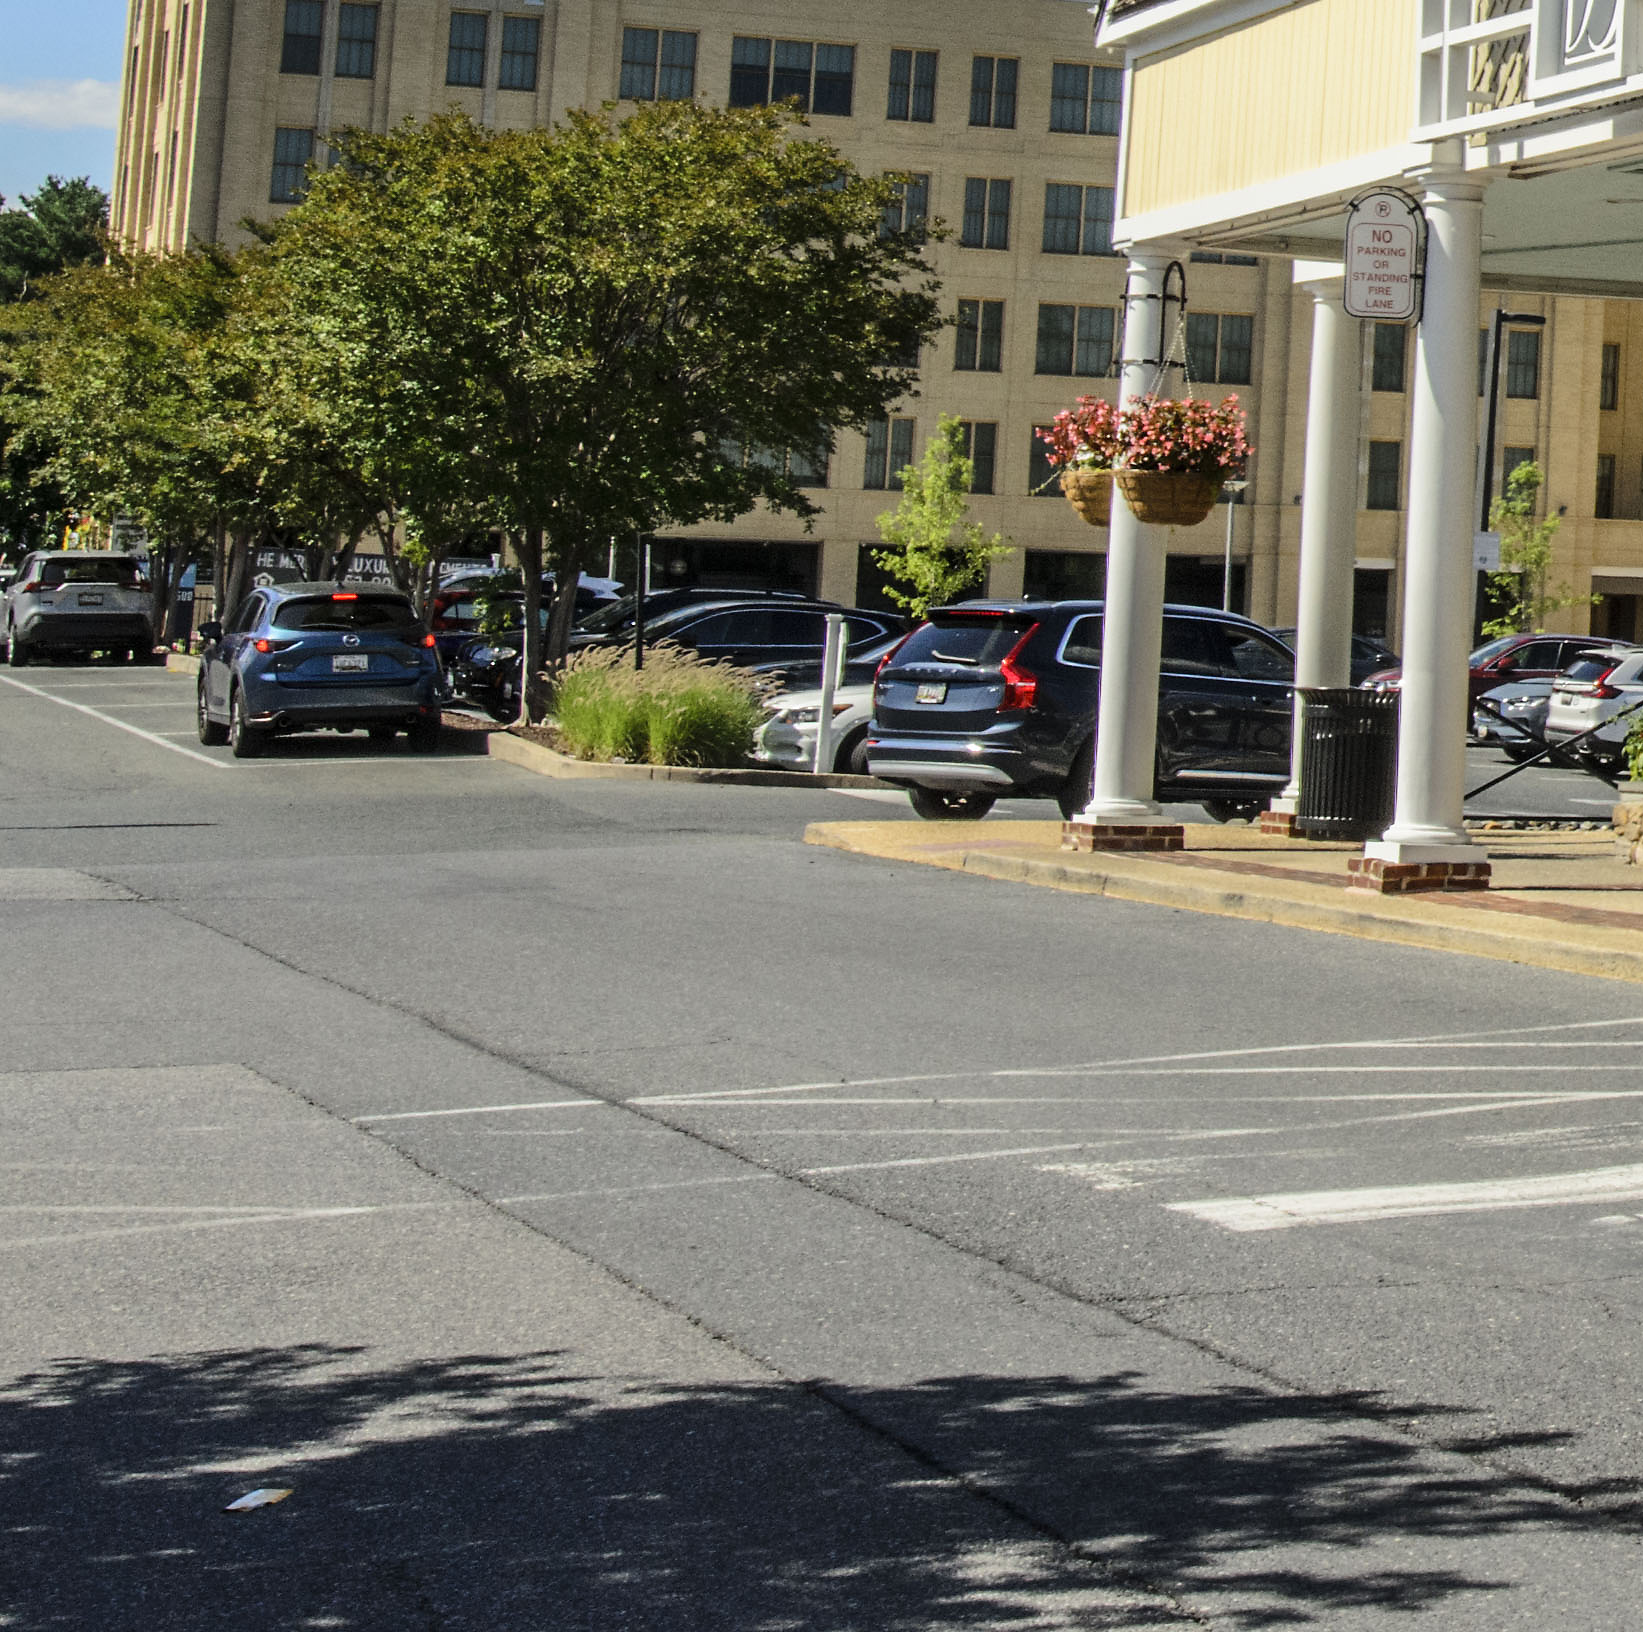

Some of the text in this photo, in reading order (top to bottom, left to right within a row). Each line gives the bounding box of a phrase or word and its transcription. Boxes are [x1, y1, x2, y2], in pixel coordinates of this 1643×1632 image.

[1372, 230, 1393, 243] NO
[1357, 246, 1406, 257] PARKING
[1373, 260, 1389, 269] OR
[1352, 272, 1408, 284] STANDING
[1368, 287, 1392, 296] FIRE
[1365, 299, 1393, 309] LANE
